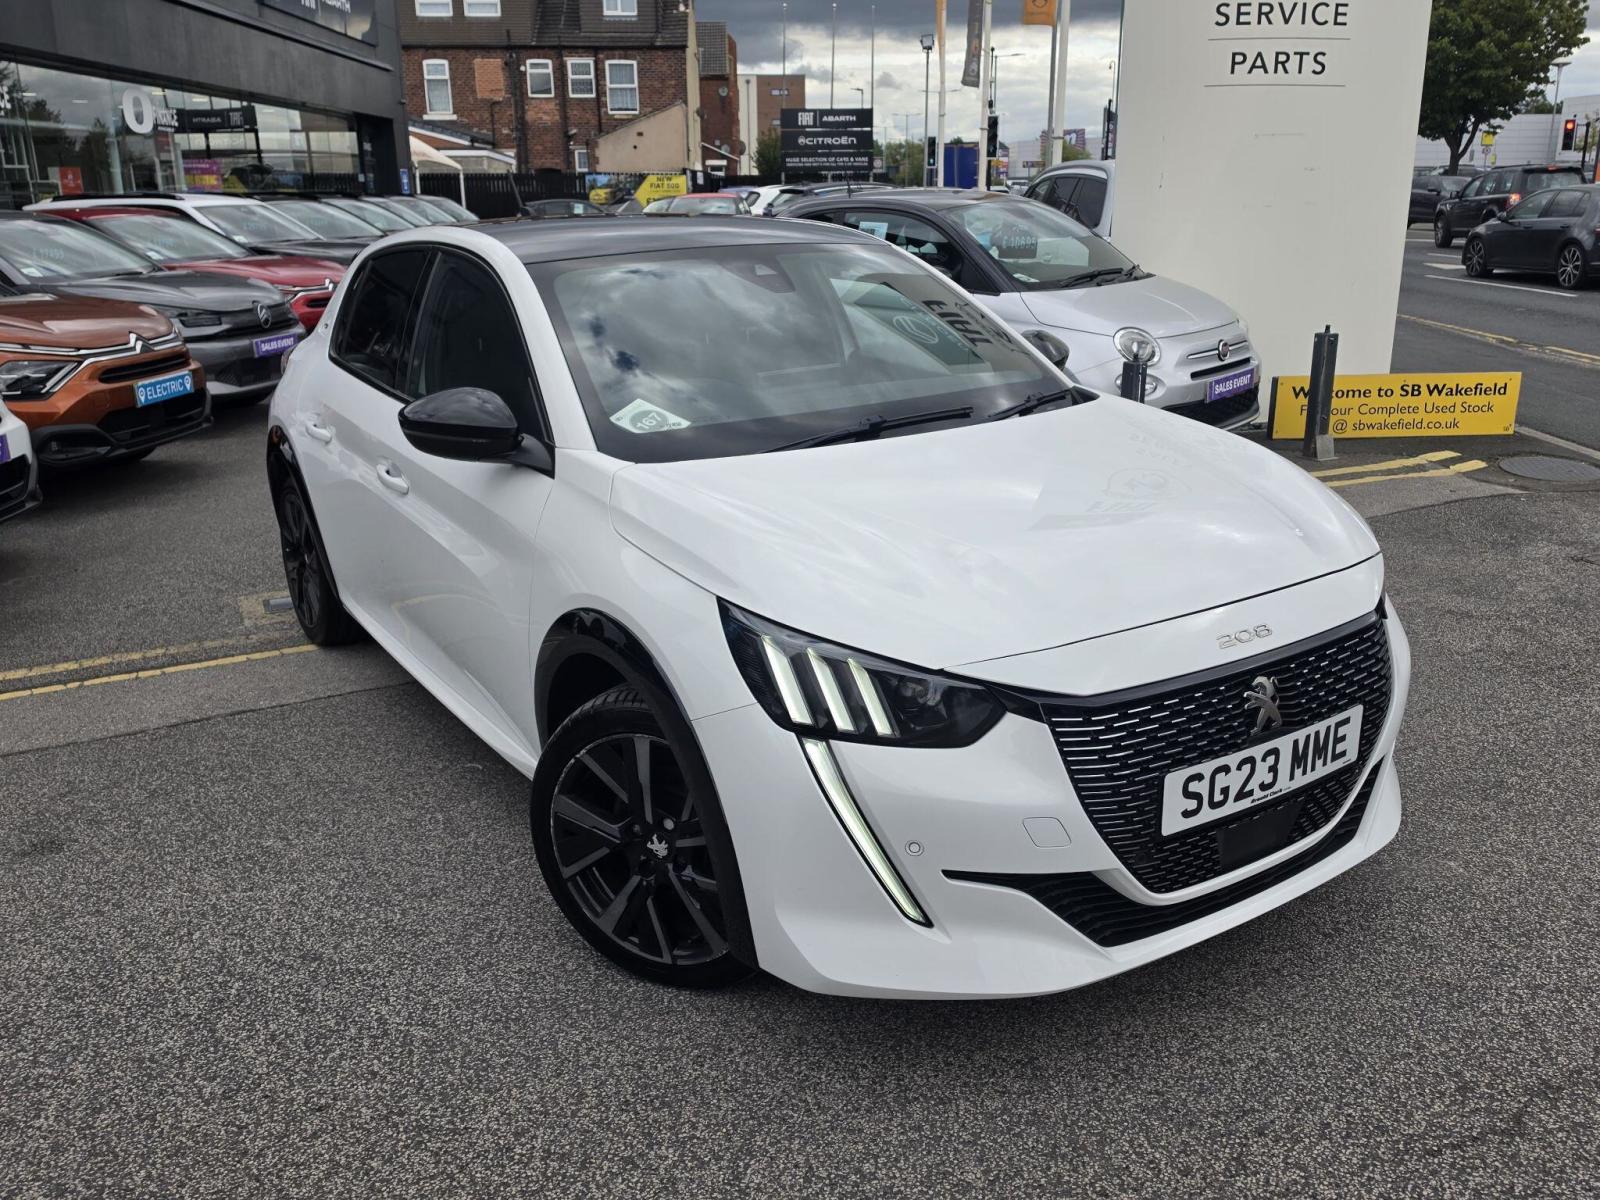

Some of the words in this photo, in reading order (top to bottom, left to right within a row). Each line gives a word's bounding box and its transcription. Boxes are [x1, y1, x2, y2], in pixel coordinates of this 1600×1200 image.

[1214, 2, 1349, 26] SERVICE
[1230, 51, 1327, 75] PARTS
[798, 112, 814, 126] FIAT
[805, 135, 857, 145] CITROËN
[261, 341, 278, 351] SALES
[146, 379, 184, 400] ELECTRIC
[1214, 380, 1233, 395] SALES
[1233, 374, 1251, 389] EVENT
[1292, 385, 1372, 399] Wome
[1377, 385, 1394, 398] to
[1400, 383, 1422, 398] SB
[1426, 382, 1508, 397] Wakefield
[1331, 406, 1354, 416] our
[1358, 402, 1420, 417] Complete
[1424, 401, 1456, 414] Used
[1460, 401, 1494, 413] Stock
[636, 412, 661, 429] 167
[1332, 418, 1348, 434] @
[1352, 417, 1460, 431] sbwakefield.co.uk
[1216, 624, 1273, 650] 208
[1180, 746, 1281, 819] SG23
[1288, 716, 1352, 782] MME
